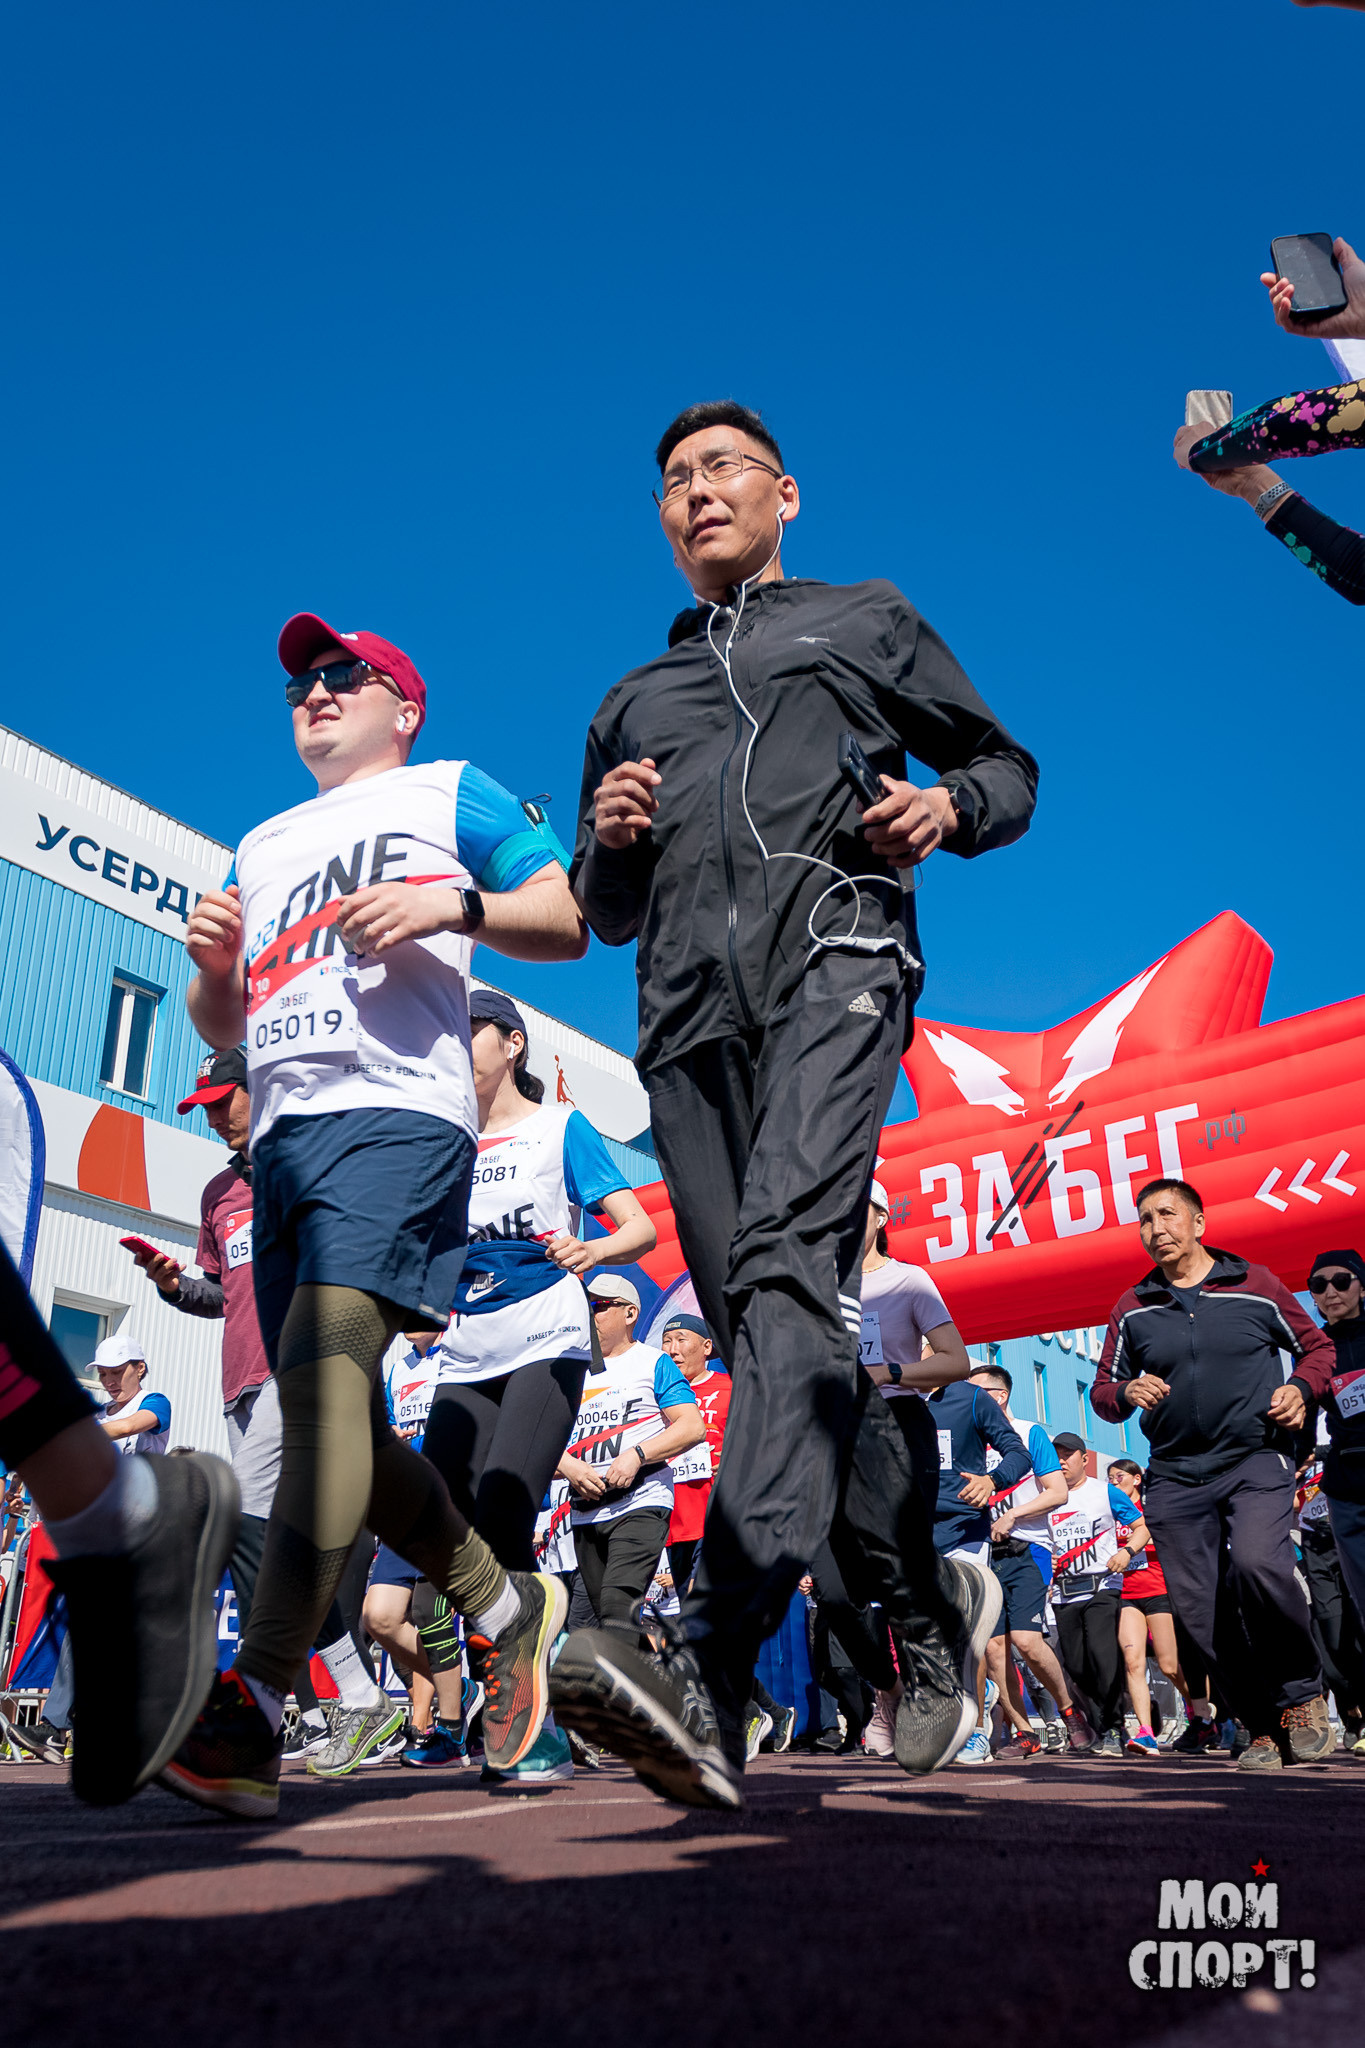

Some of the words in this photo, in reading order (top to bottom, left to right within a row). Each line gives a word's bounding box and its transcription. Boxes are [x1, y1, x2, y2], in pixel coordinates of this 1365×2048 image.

[256, 977, 270, 993] 10
[256, 1009, 343, 1049] 05019
[472, 1165, 517, 1186] 5081
[1341, 1393, 1365, 1411] 051
[577, 1409, 618, 1426] 00046
[1056, 1526, 1086, 1537] 05146
